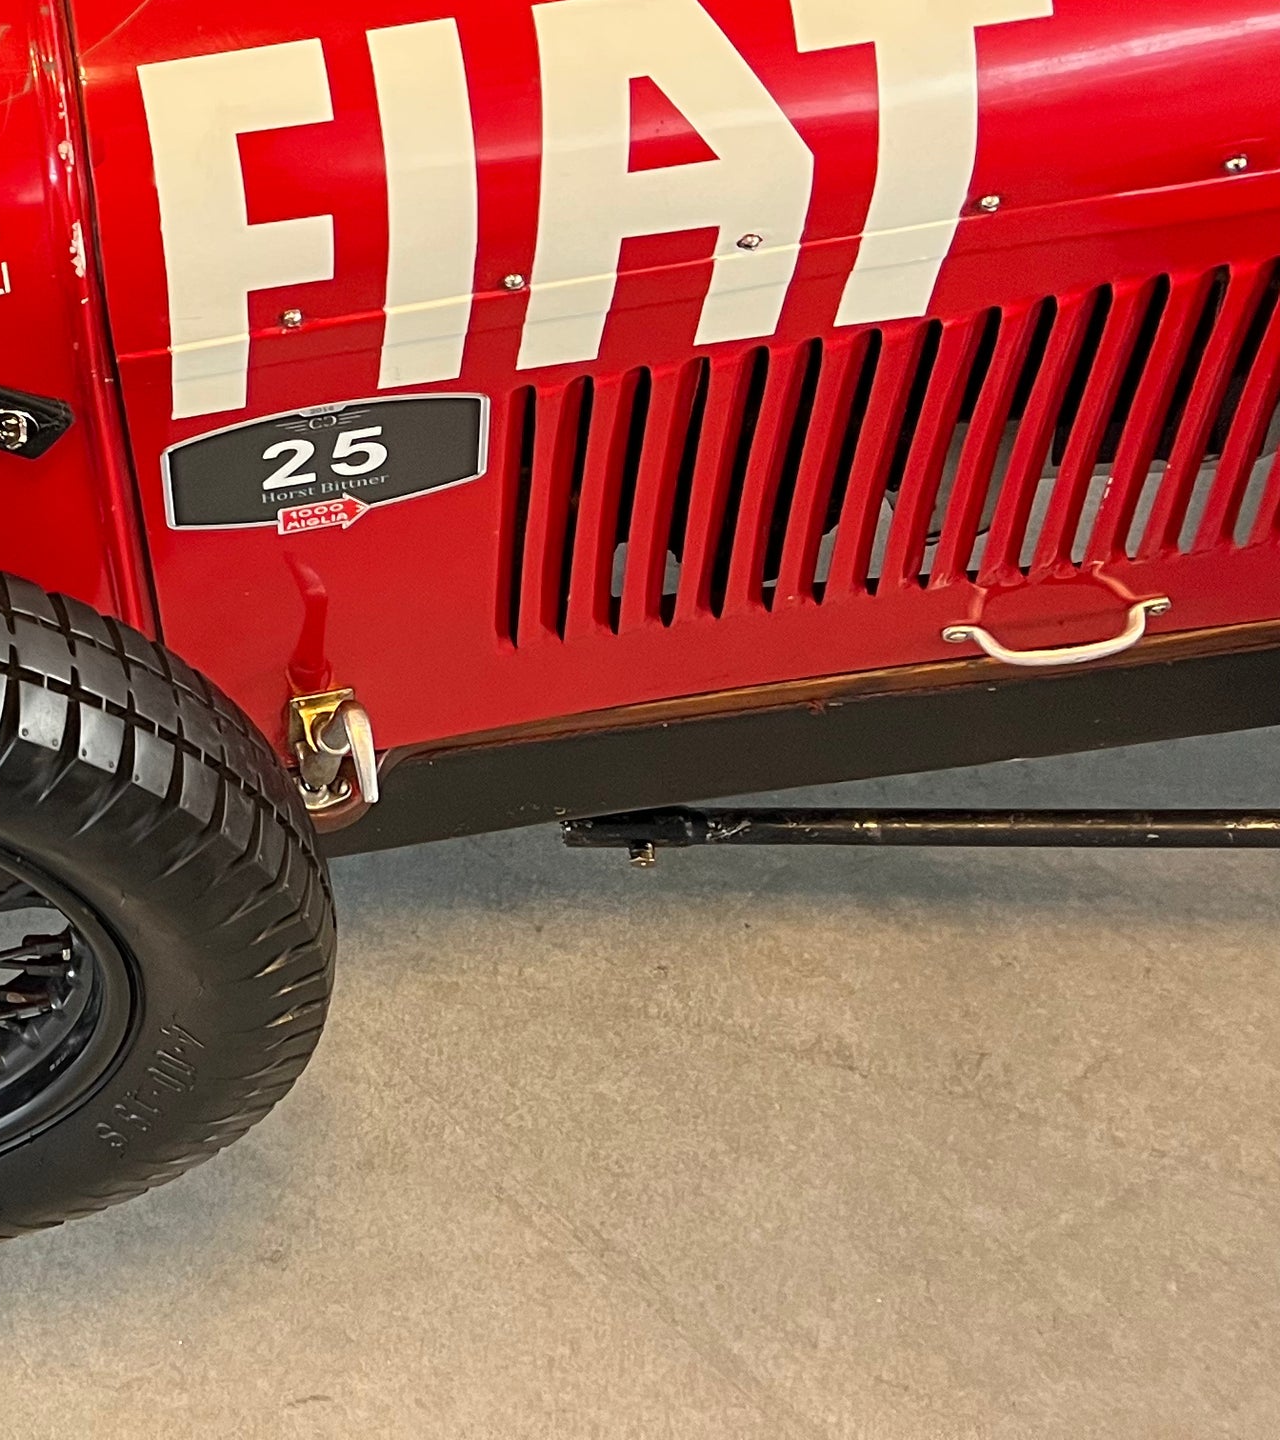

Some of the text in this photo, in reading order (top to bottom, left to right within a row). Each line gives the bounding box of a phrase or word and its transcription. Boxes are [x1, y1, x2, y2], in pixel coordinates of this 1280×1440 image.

[262, 426, 388, 490] 25
[262, 475, 389, 503] Horst Bittner
[287, 512, 348, 530] MIGLIA
[289, 503, 344, 519] 1000
